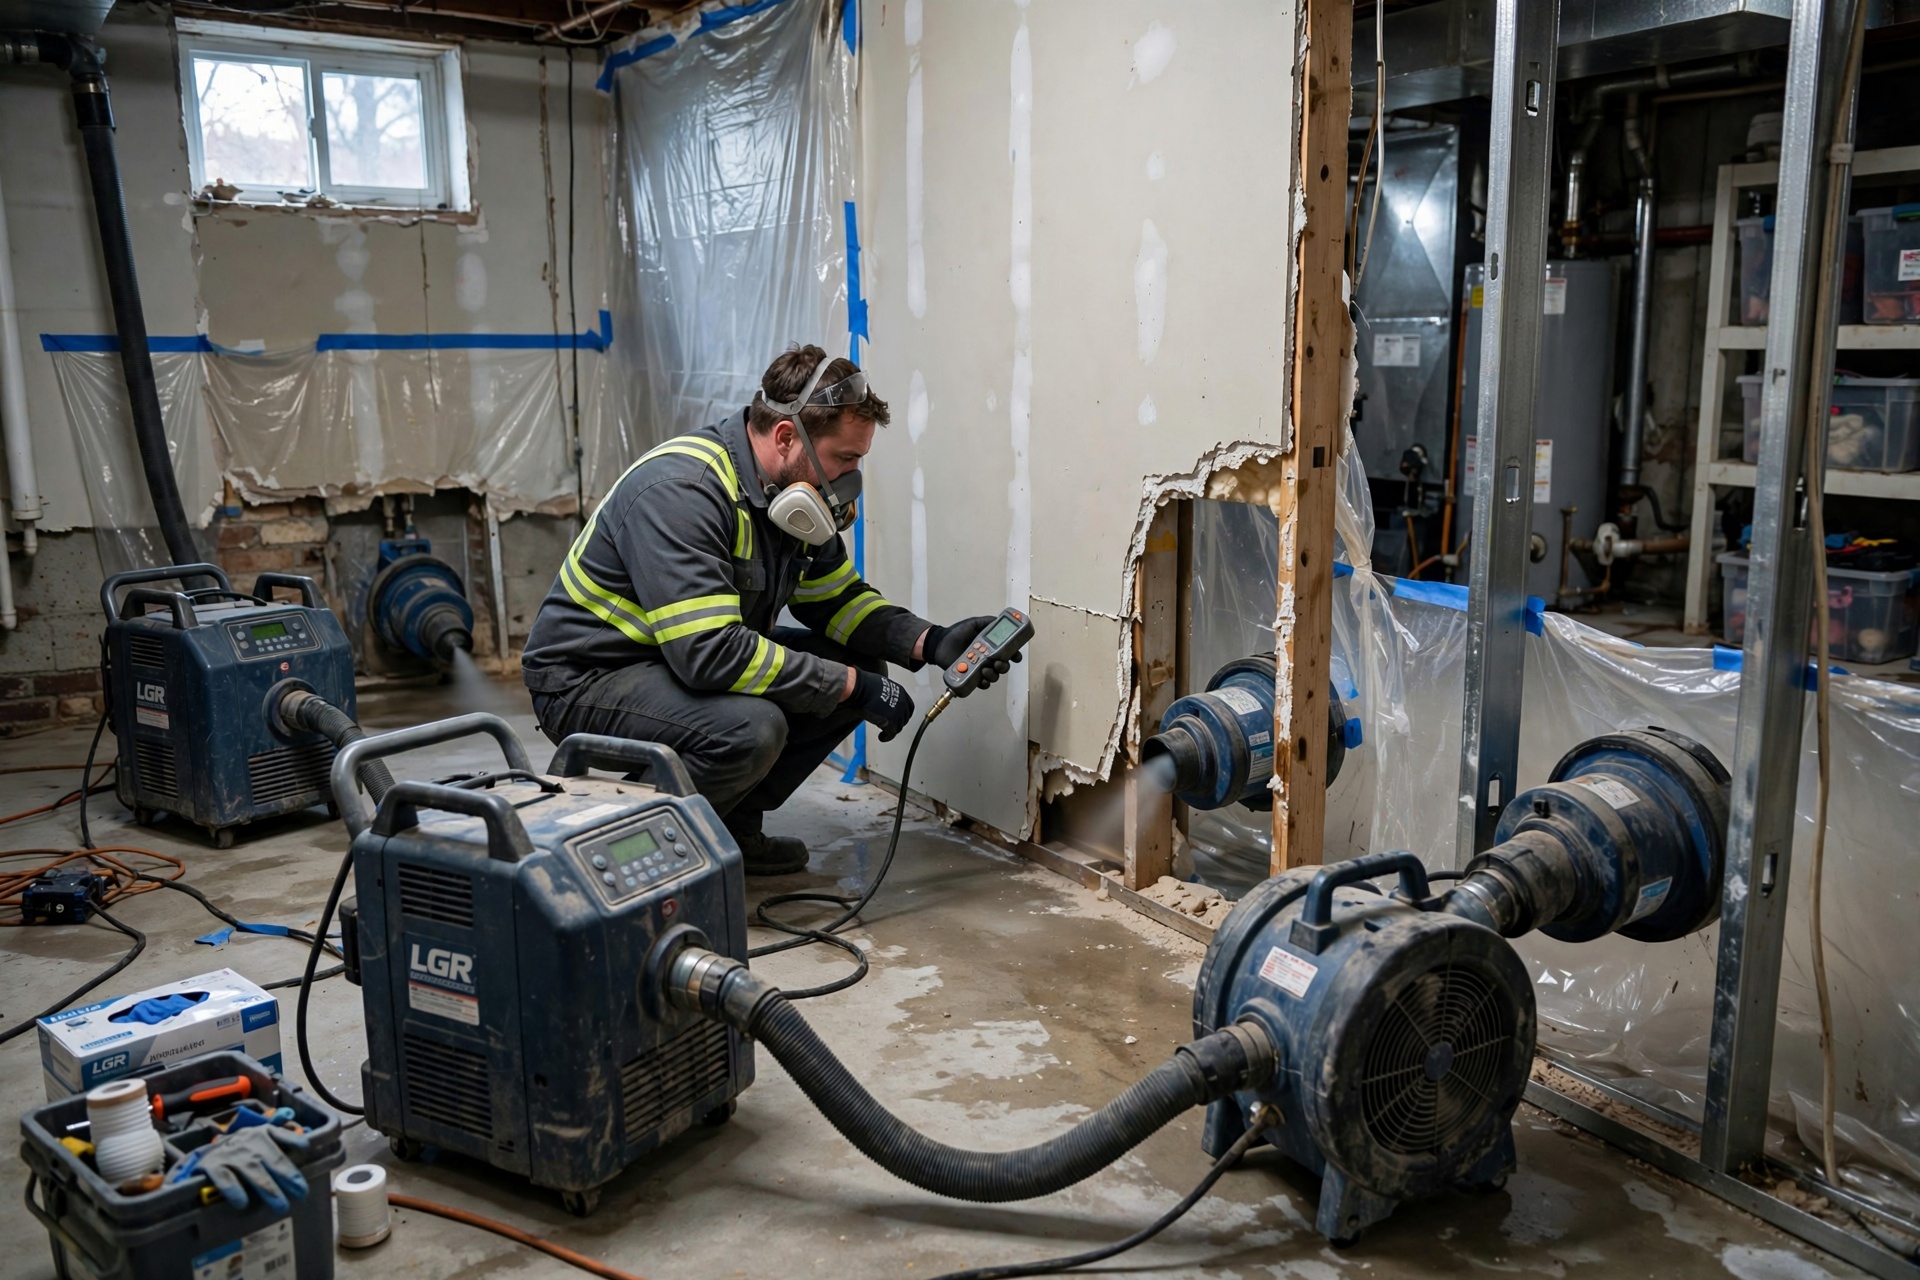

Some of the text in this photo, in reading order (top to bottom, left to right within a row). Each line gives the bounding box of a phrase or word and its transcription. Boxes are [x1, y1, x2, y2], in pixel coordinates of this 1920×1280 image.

[136, 681, 165, 705] LGR
[410, 943, 473, 984] LGR
[92, 1054, 127, 1074] LGR
